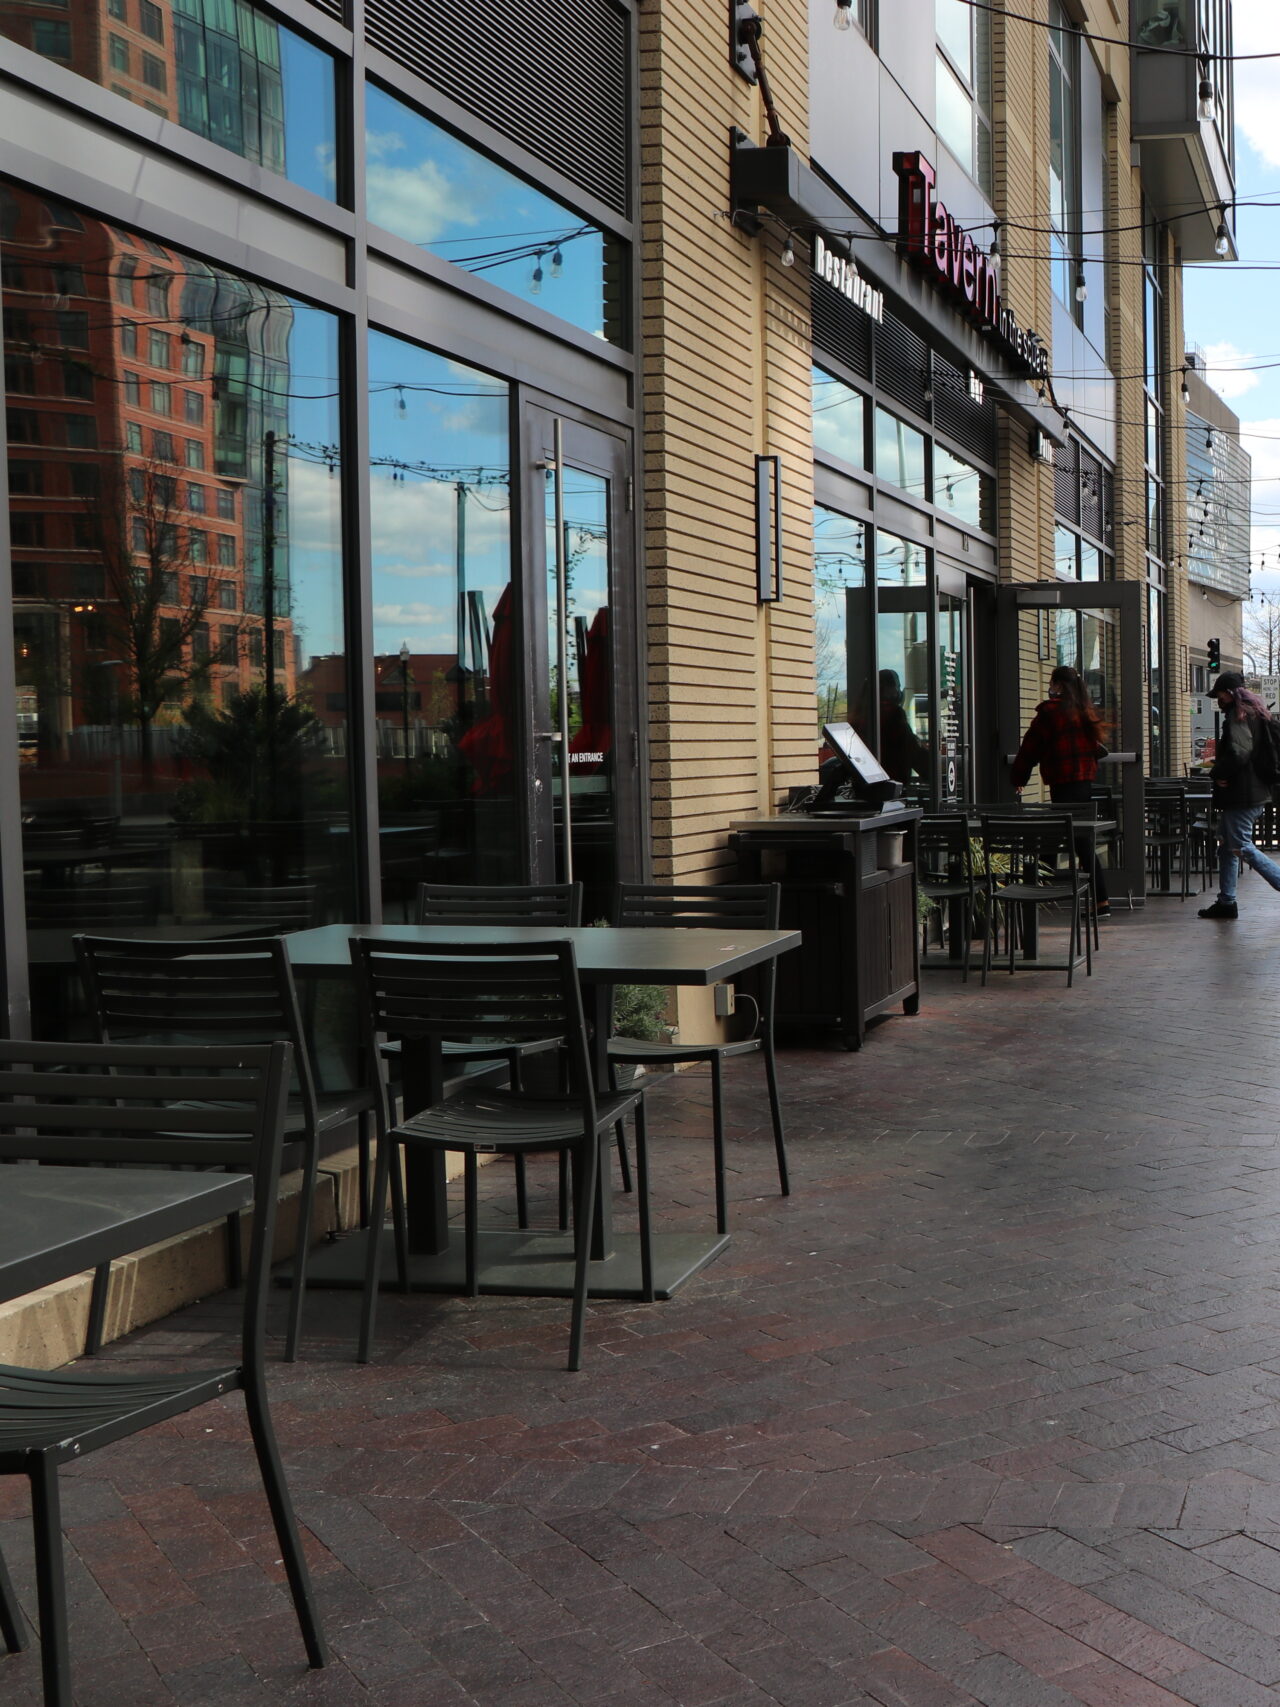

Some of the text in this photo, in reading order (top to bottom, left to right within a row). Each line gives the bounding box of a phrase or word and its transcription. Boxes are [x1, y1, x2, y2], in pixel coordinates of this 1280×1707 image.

[815, 234, 884, 324] Restaurant
[897, 151, 998, 327] Tavern
[1023, 333, 1047, 377] square
[571, 753, 578, 763] AN
[579, 752, 604, 762] ENTRANCE
